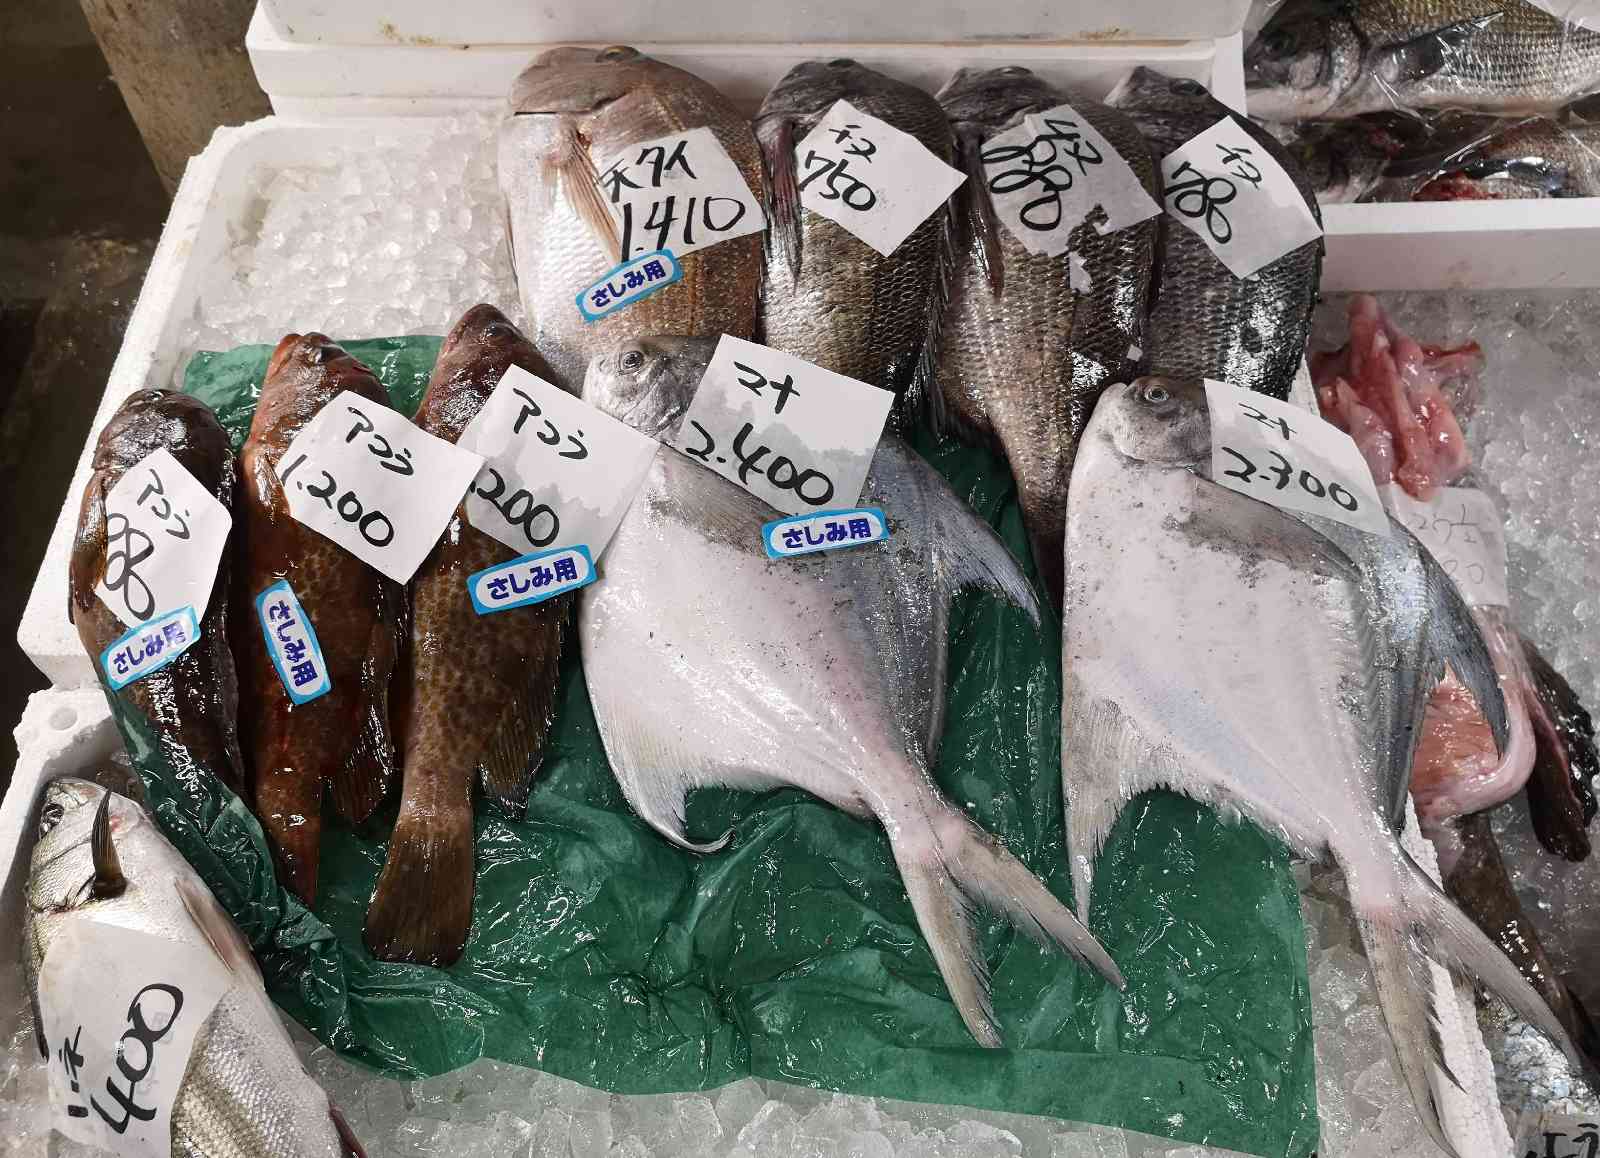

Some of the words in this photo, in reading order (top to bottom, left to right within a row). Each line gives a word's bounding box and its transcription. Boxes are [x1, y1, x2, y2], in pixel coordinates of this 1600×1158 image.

[828, 124, 877, 164] チヌ
[1215, 143, 1263, 191] チヌ
[799, 150, 877, 211] 750
[619, 195, 746, 263] 1.410
[590, 259, 667, 309] さしみ用
[346, 406, 415, 477] アコウ
[513, 387, 589, 461] アコウ
[685, 419, 834, 505] 2.400
[137, 468, 190, 540] アコウ
[280, 454, 395, 548] 1.200
[782, 517, 872, 550] さしみ用
[486, 556, 578, 600] さしみ用
[112, 620, 187, 674] さしみ用
[268, 599, 319, 687] さしみ用
[90, 983, 184, 1134] 400
